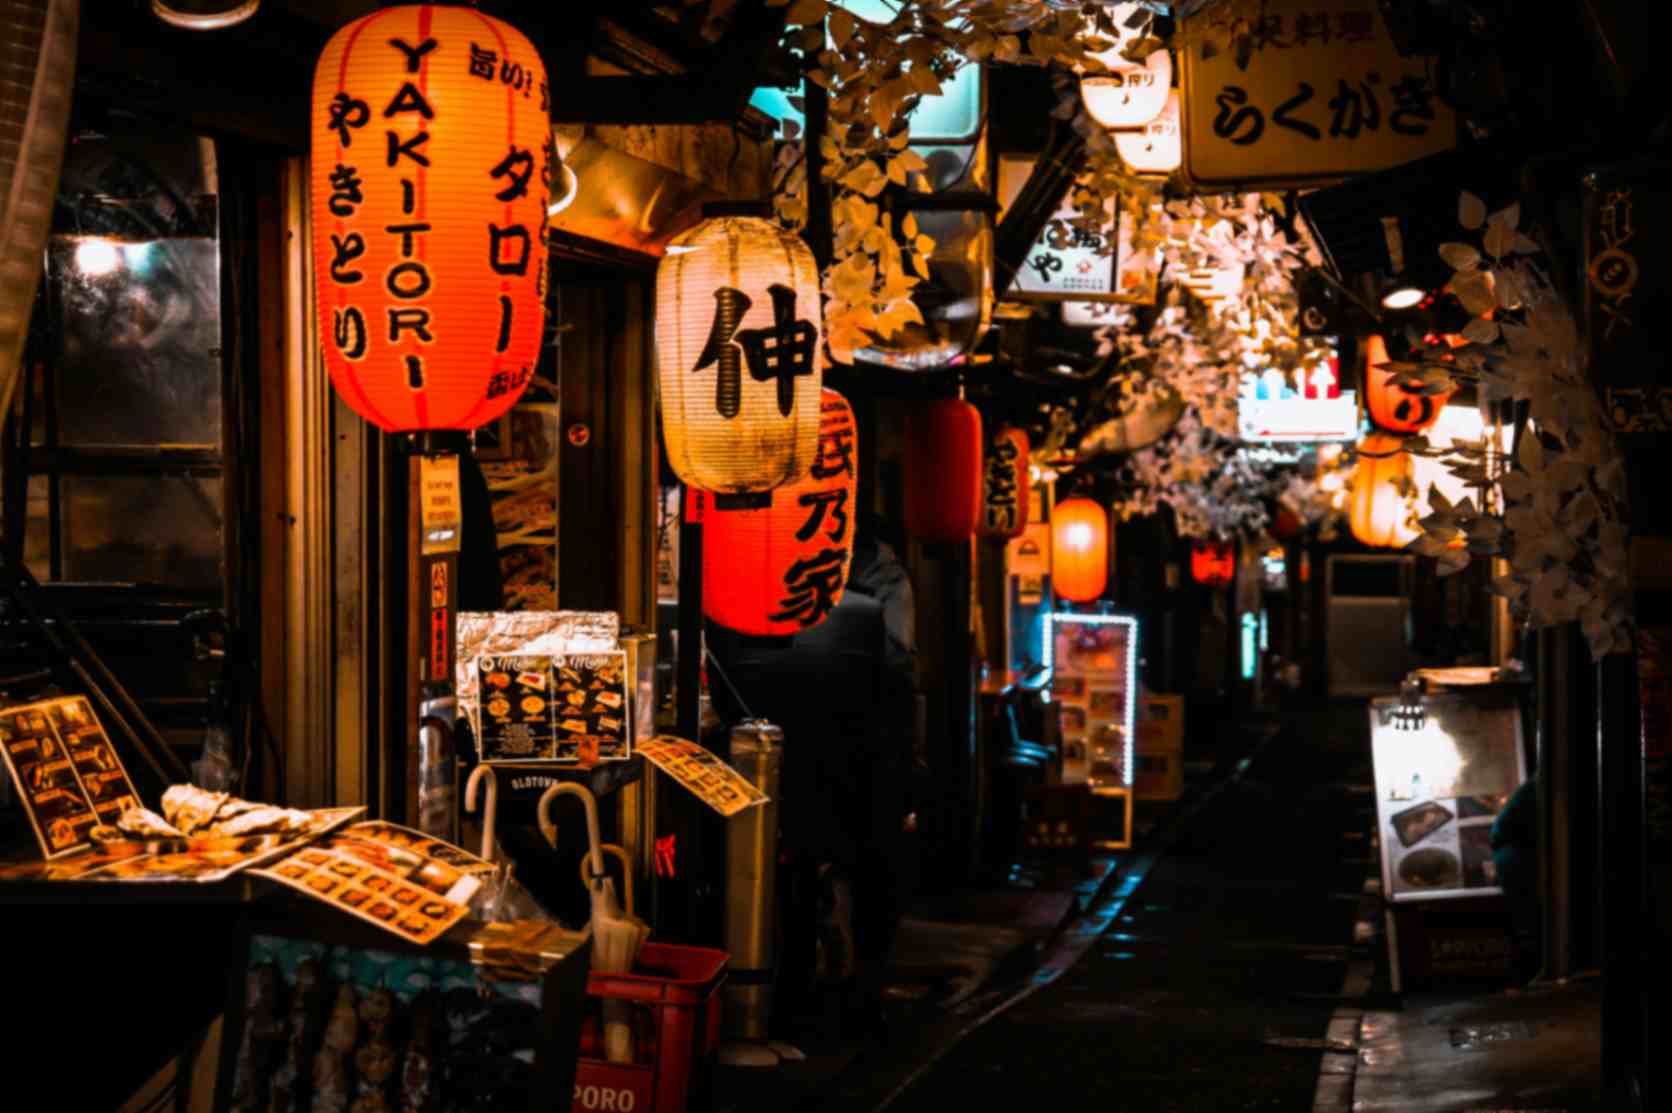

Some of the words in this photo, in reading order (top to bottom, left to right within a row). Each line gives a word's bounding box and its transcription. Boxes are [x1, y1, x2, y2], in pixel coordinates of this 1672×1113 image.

[1213, 72, 1434, 145] らくがき
[328, 92, 373, 360] やきとり
[383, 38, 438, 389] YAKITORI
[489, 145, 535, 353] タロー
[692, 283, 818, 419] 伸
